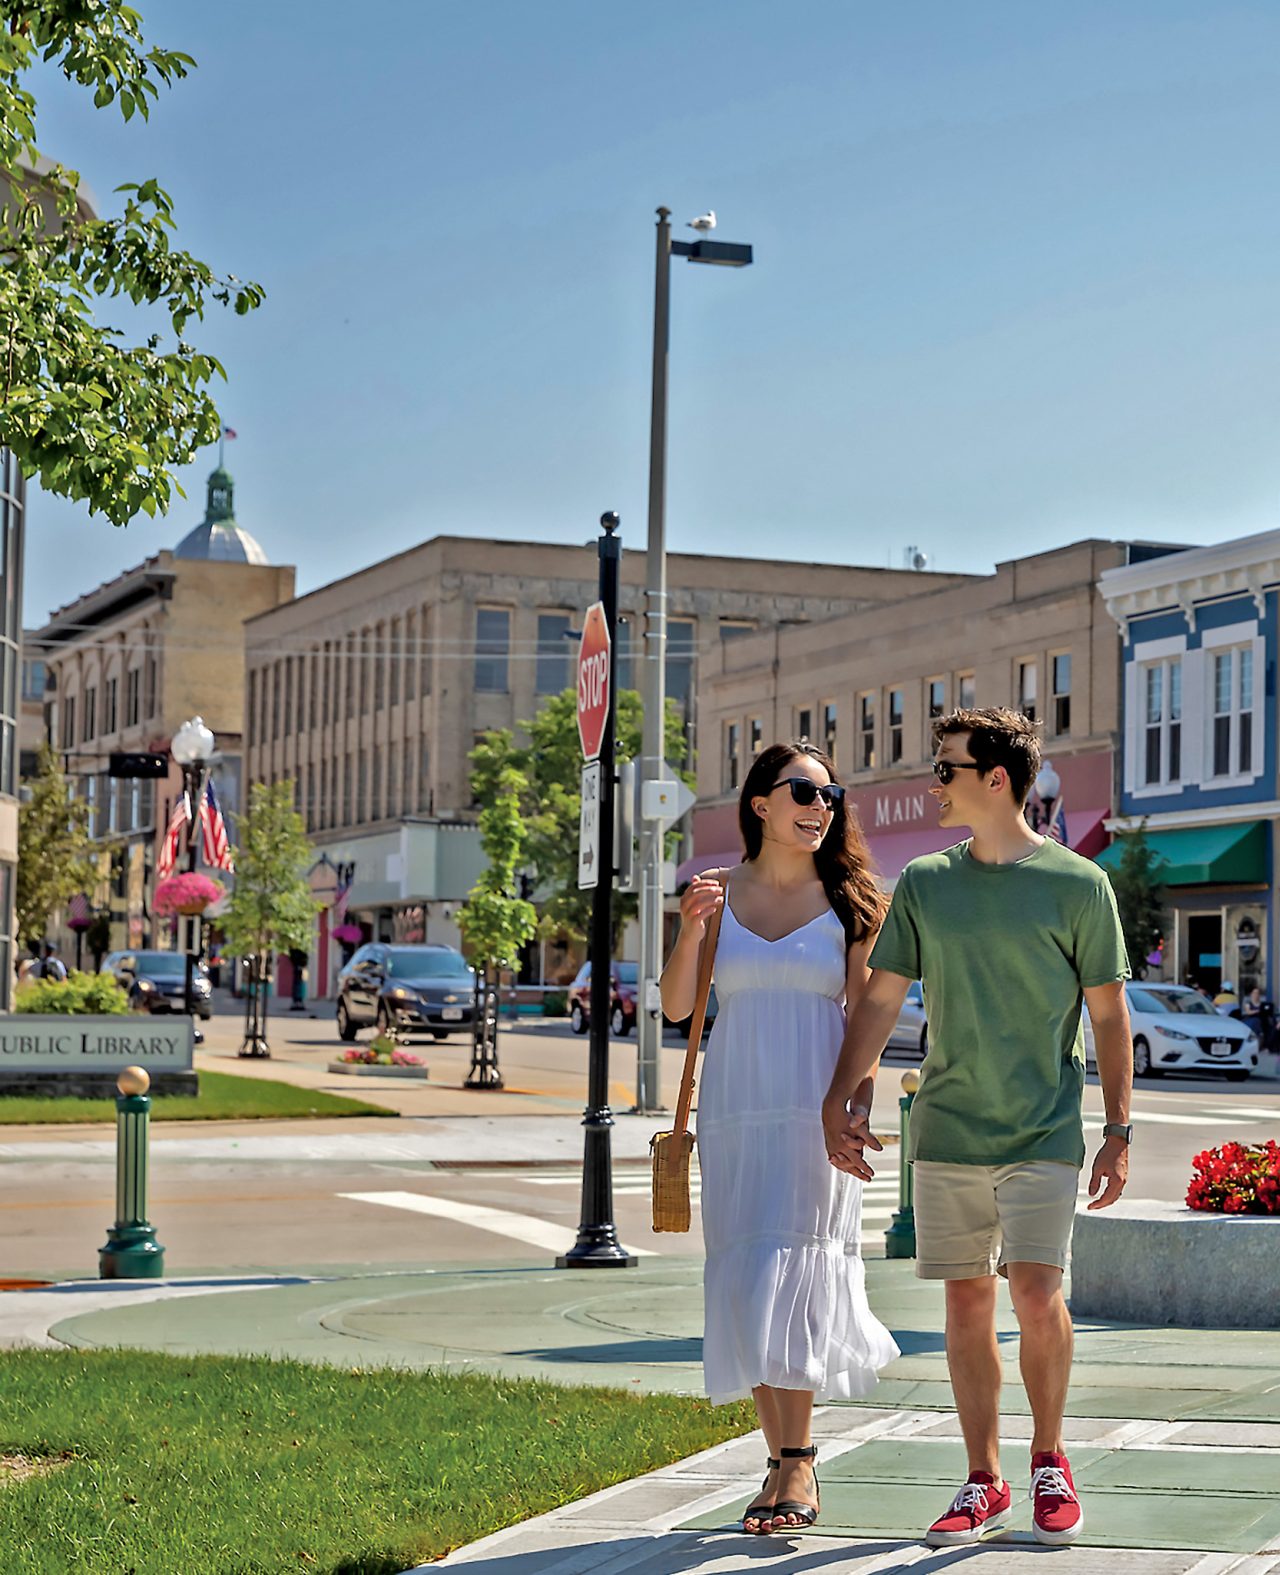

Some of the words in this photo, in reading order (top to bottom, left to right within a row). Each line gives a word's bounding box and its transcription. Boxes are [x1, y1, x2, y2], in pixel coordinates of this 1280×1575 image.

[579, 650, 608, 712] STOP
[875, 794, 924, 827] MAIN
[0, 1033, 72, 1055] UBLIC
[81, 1033, 179, 1056] LIBRARY
